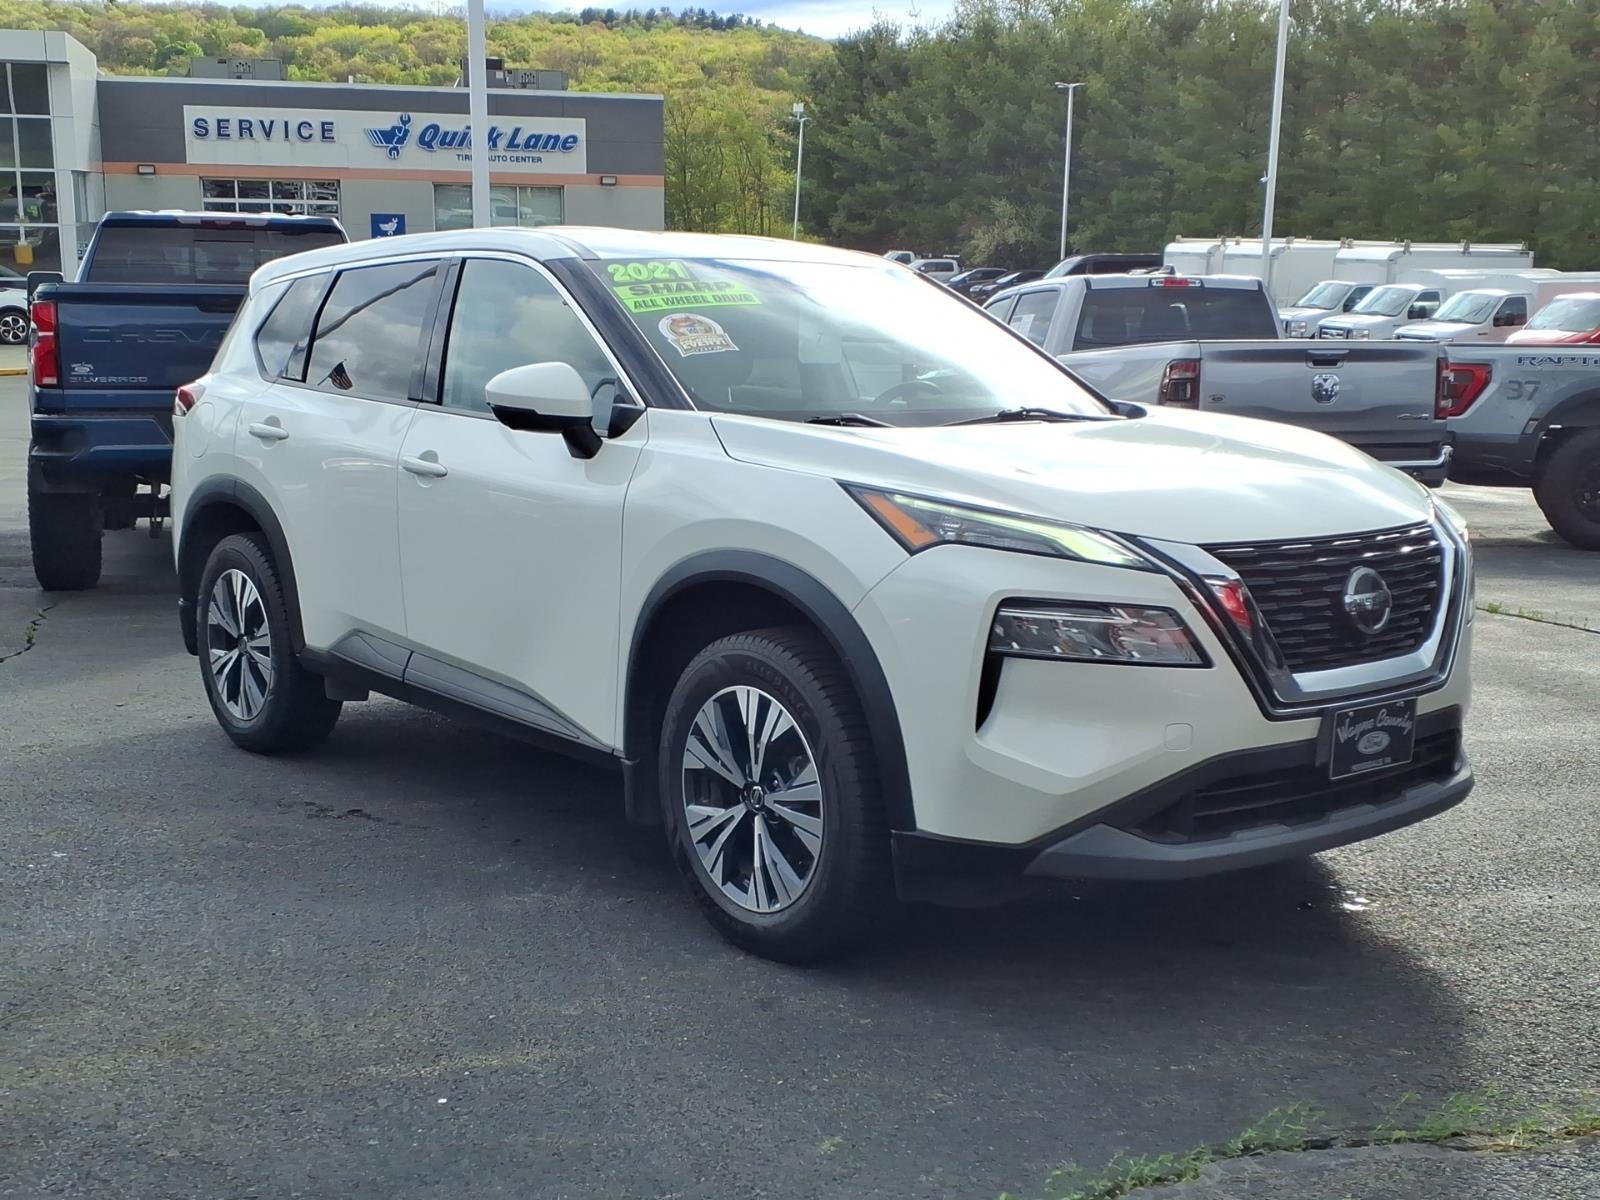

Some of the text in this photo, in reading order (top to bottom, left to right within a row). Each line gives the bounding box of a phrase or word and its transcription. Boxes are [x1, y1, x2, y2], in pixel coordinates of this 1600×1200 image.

[193, 117, 335, 140] SERVICE
[418, 123, 578, 151] Quik Lane
[607, 262, 689, 281] 2021
[628, 281, 734, 296] SHARP
[633, 292, 752, 310] ALL WHEEL DRIVE
[1506, 380, 1541, 400] 37
